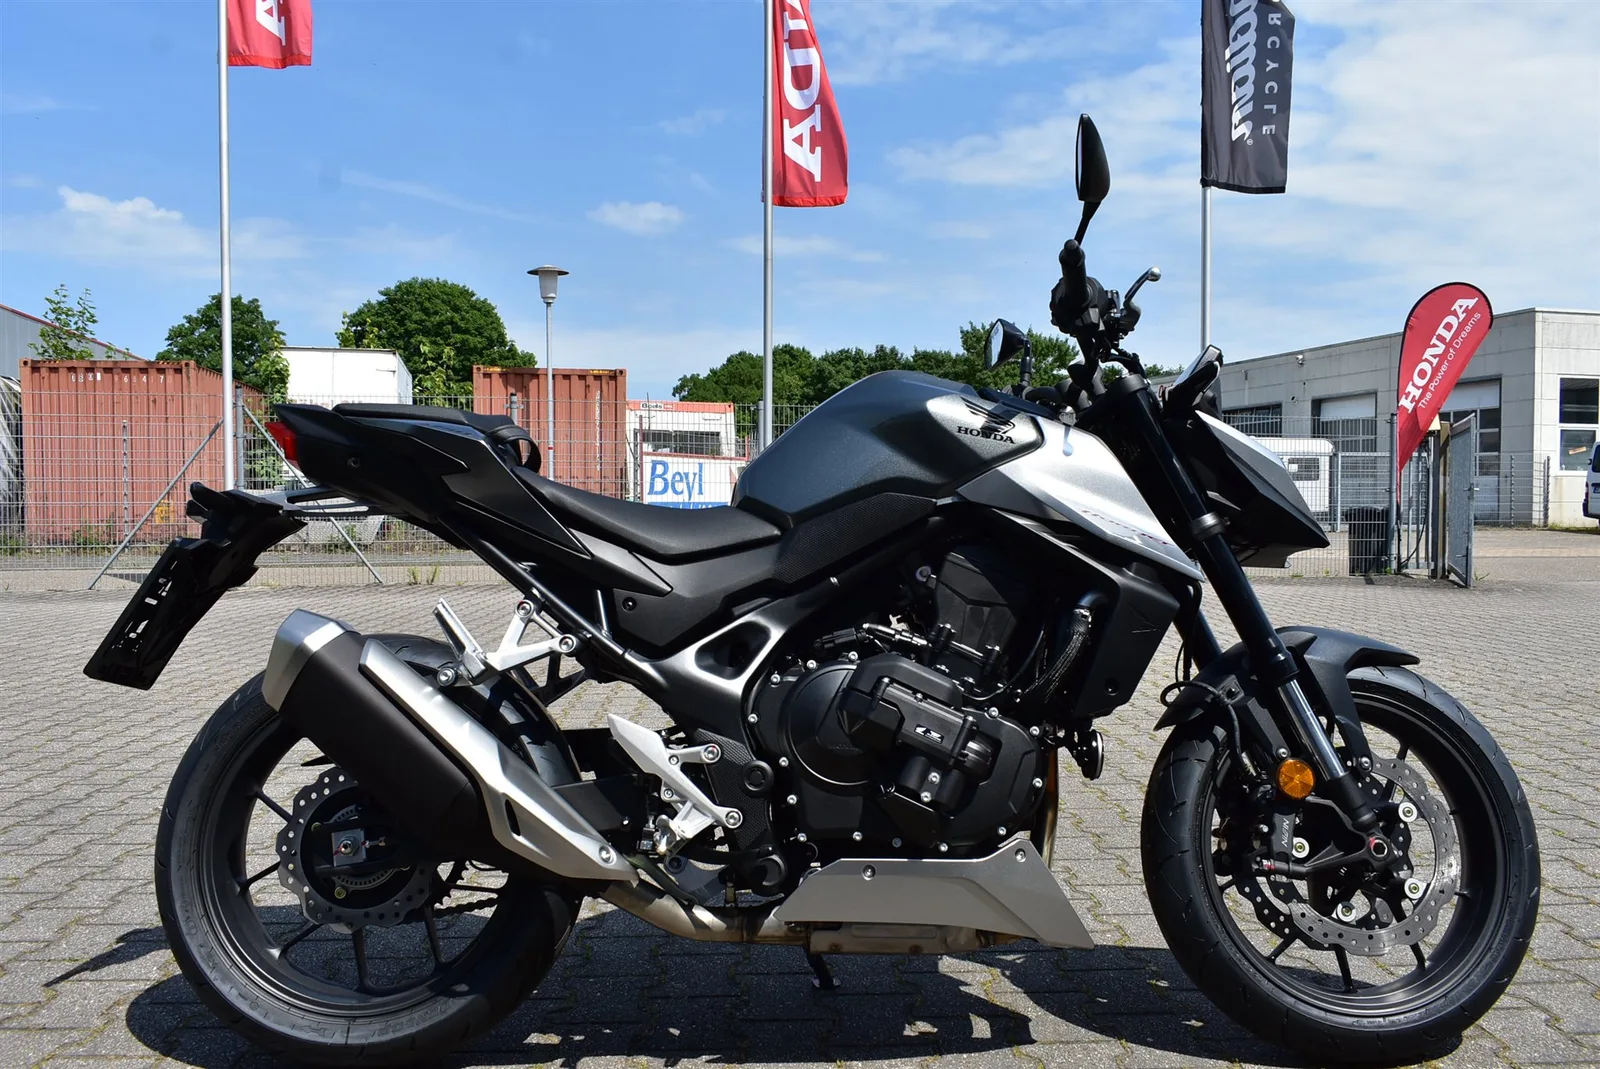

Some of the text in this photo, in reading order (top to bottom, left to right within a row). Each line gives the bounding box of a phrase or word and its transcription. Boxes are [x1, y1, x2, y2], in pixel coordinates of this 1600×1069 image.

[1399, 297, 1479, 413] HONDA
[1417, 312, 1482, 409] The Power of Dreams
[957, 425, 1016, 445] HONDA
[647, 459, 704, 502] Beyl
